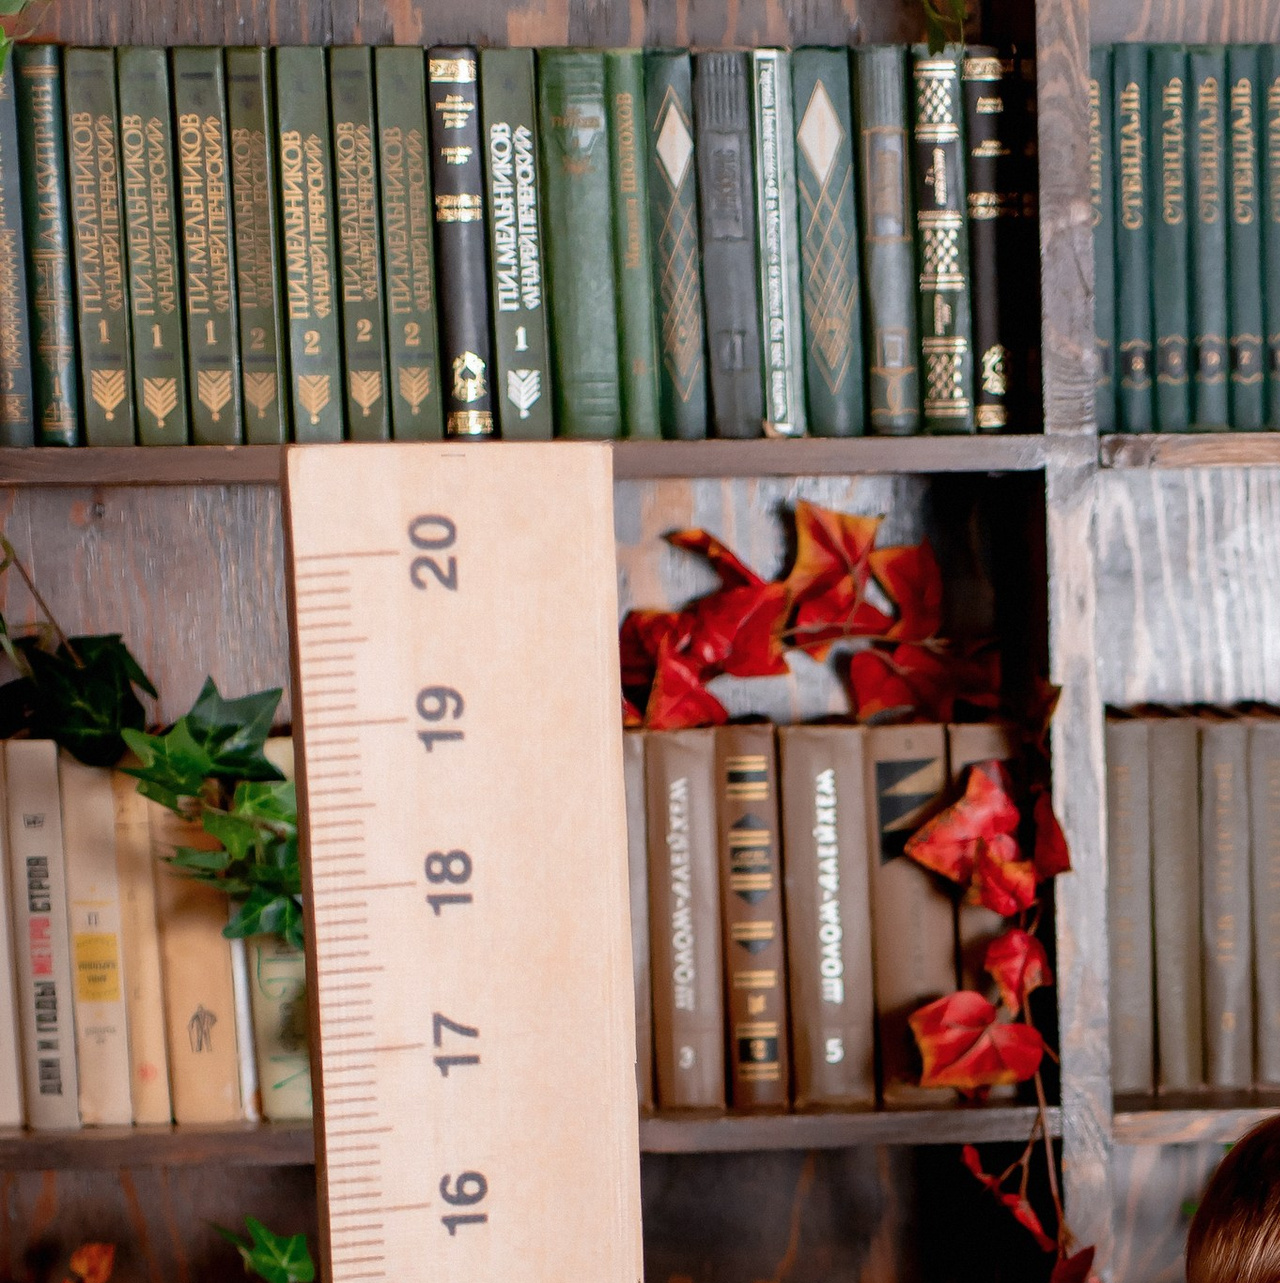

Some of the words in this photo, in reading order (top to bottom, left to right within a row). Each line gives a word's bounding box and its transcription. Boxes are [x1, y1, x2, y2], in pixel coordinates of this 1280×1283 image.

[1120, 82, 1145, 230] СТЕНДАЛЬ
[1163, 77, 1184, 225] СТЕНДАЛЬ
[1231, 77, 1256, 224] СТЕНДАЛЬ
[98, 319, 110, 343] 1
[151, 324, 163, 347] 1
[205, 320, 217, 344] 1
[304, 330, 321, 354] 2
[356, 319, 372, 341] 2
[514, 326, 529, 351] 1
[409, 514, 458, 591] 20
[417, 685, 464, 752] 19
[426, 849, 472, 916] 18
[34, 981, 58, 1032] ГОДЫ
[433, 1013, 479, 1077] 17
[825, 1038, 845, 1063] 5
[440, 1171, 488, 1236] 16
